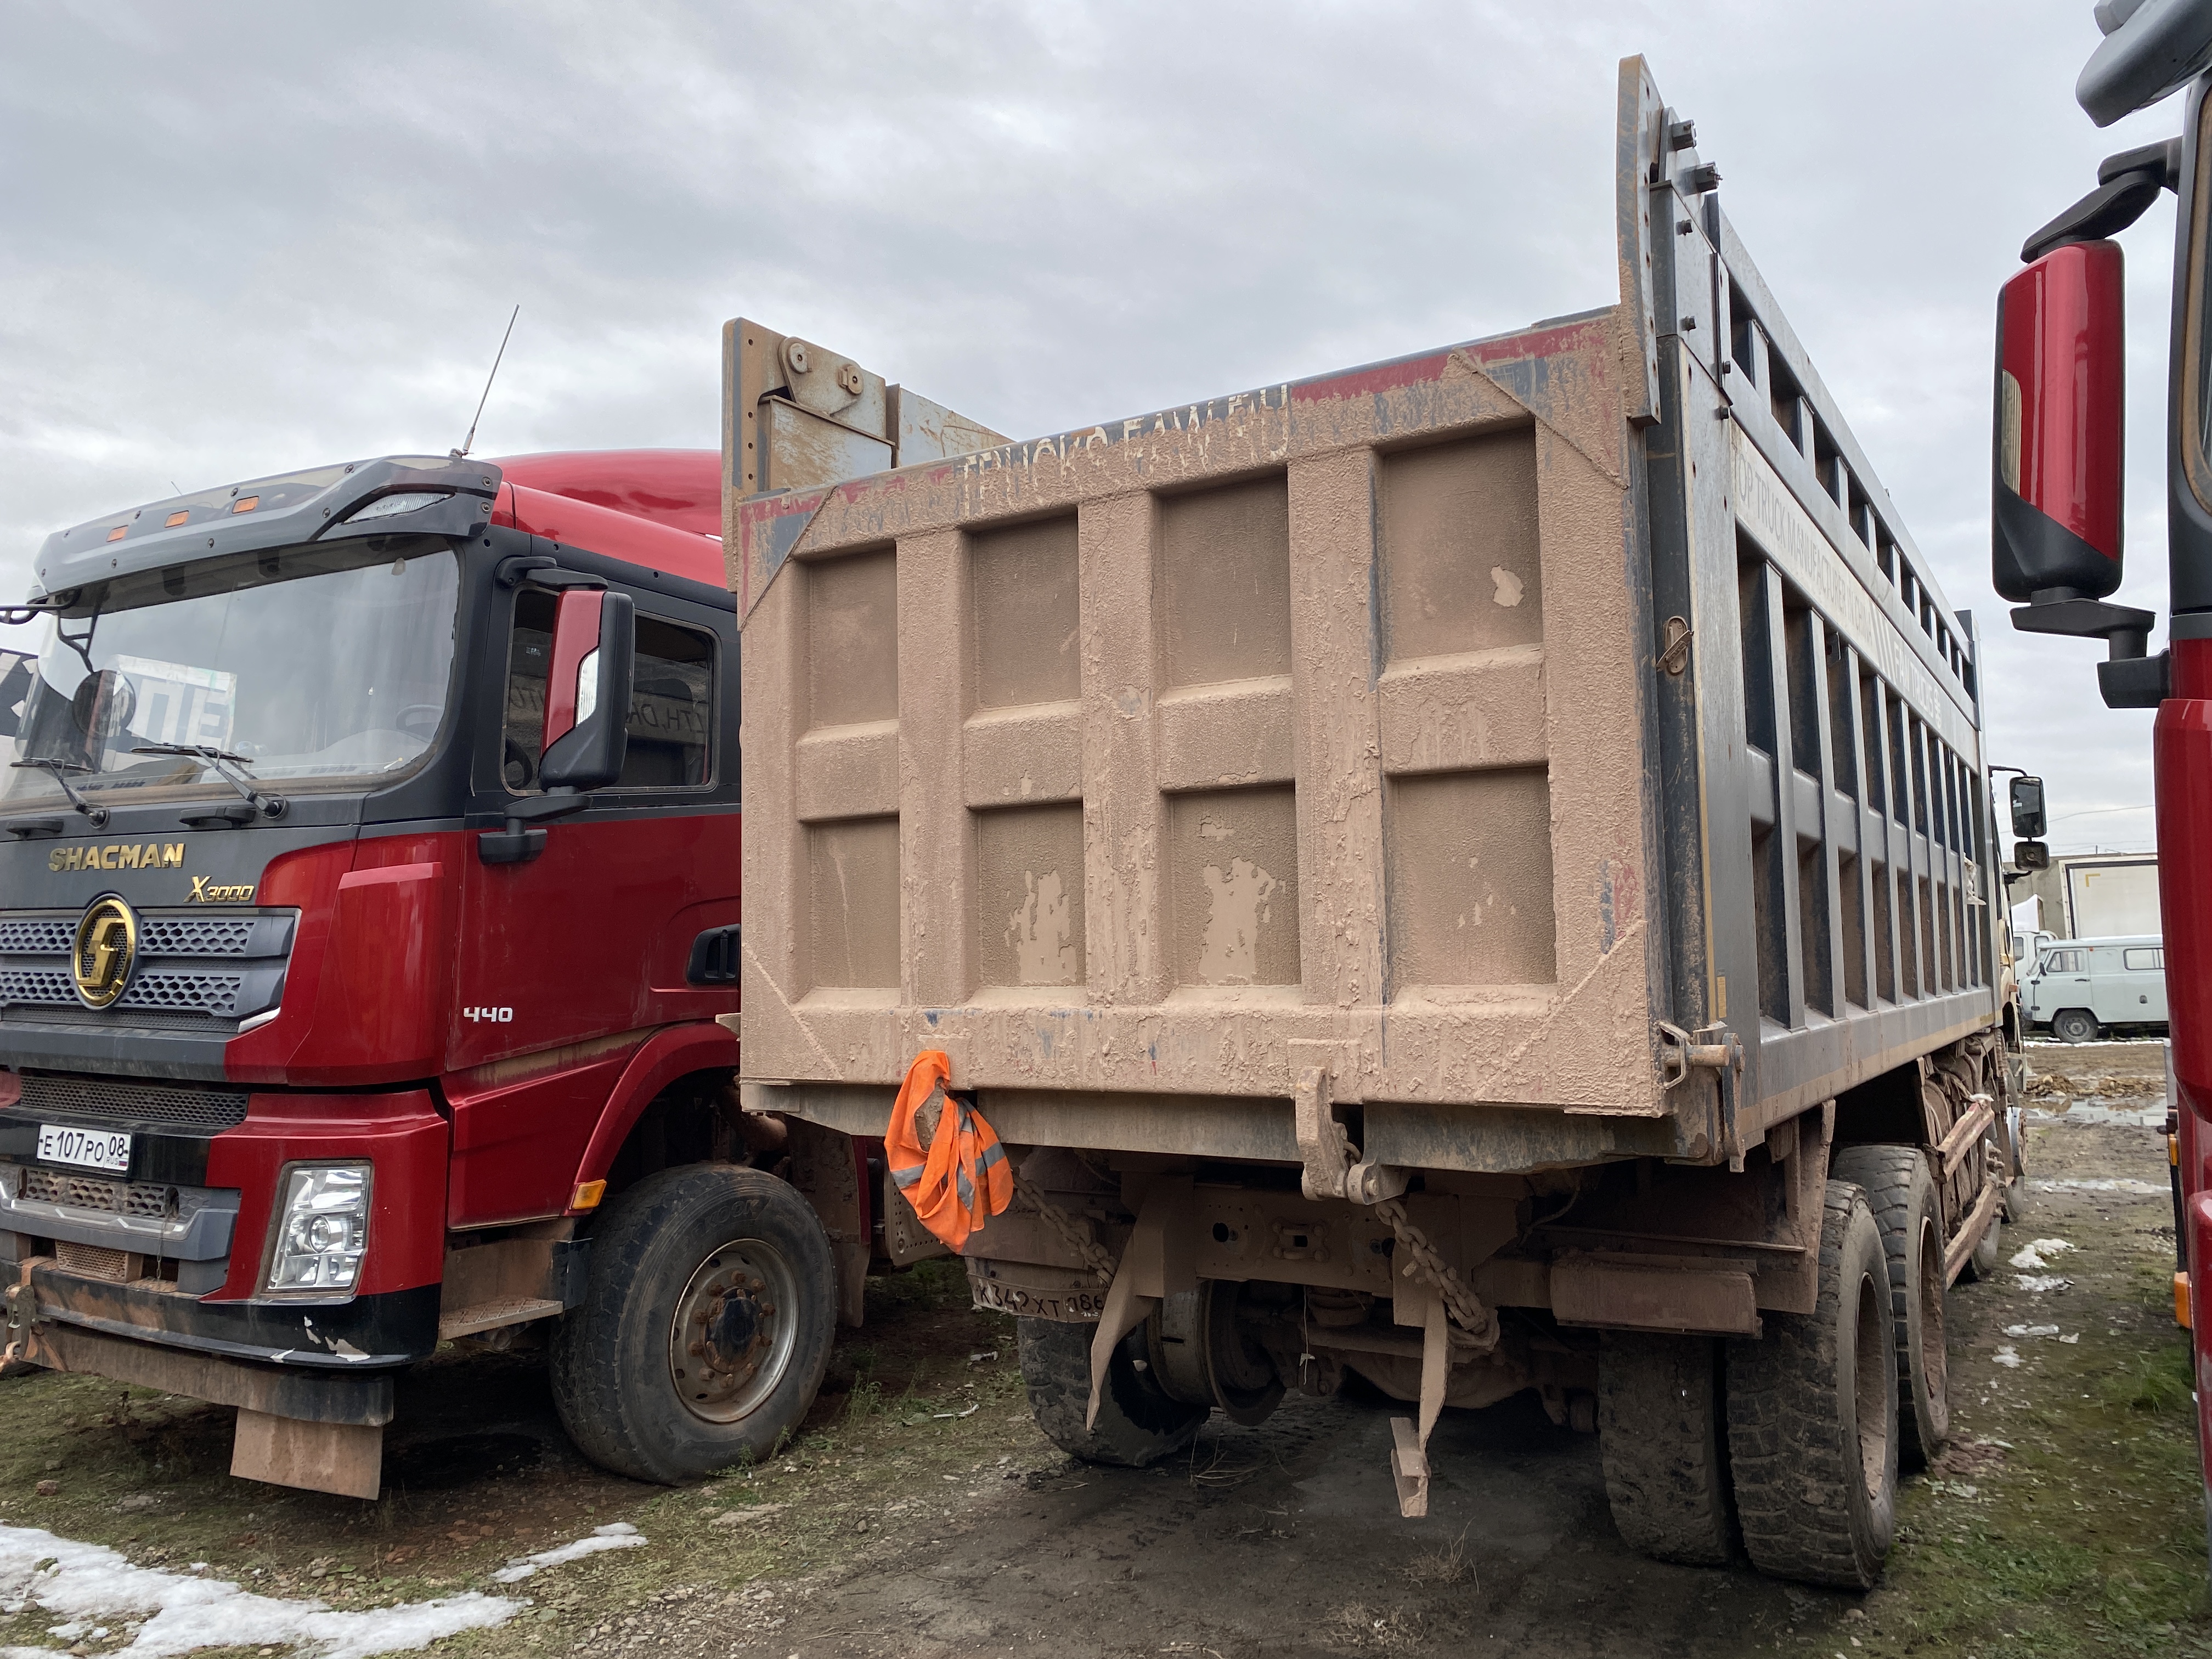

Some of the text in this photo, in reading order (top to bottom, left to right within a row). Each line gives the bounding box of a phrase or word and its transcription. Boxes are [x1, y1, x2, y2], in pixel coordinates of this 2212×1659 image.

[1755, 471, 1786, 549] TRUCK
[1787, 511, 1847, 618] MANUFACTURER
[49, 843, 185, 872] SHACMAN
[183, 876, 255, 903] X3000
[463, 1006, 513, 1023] 440
[106, 1156, 119, 1165] RUS
